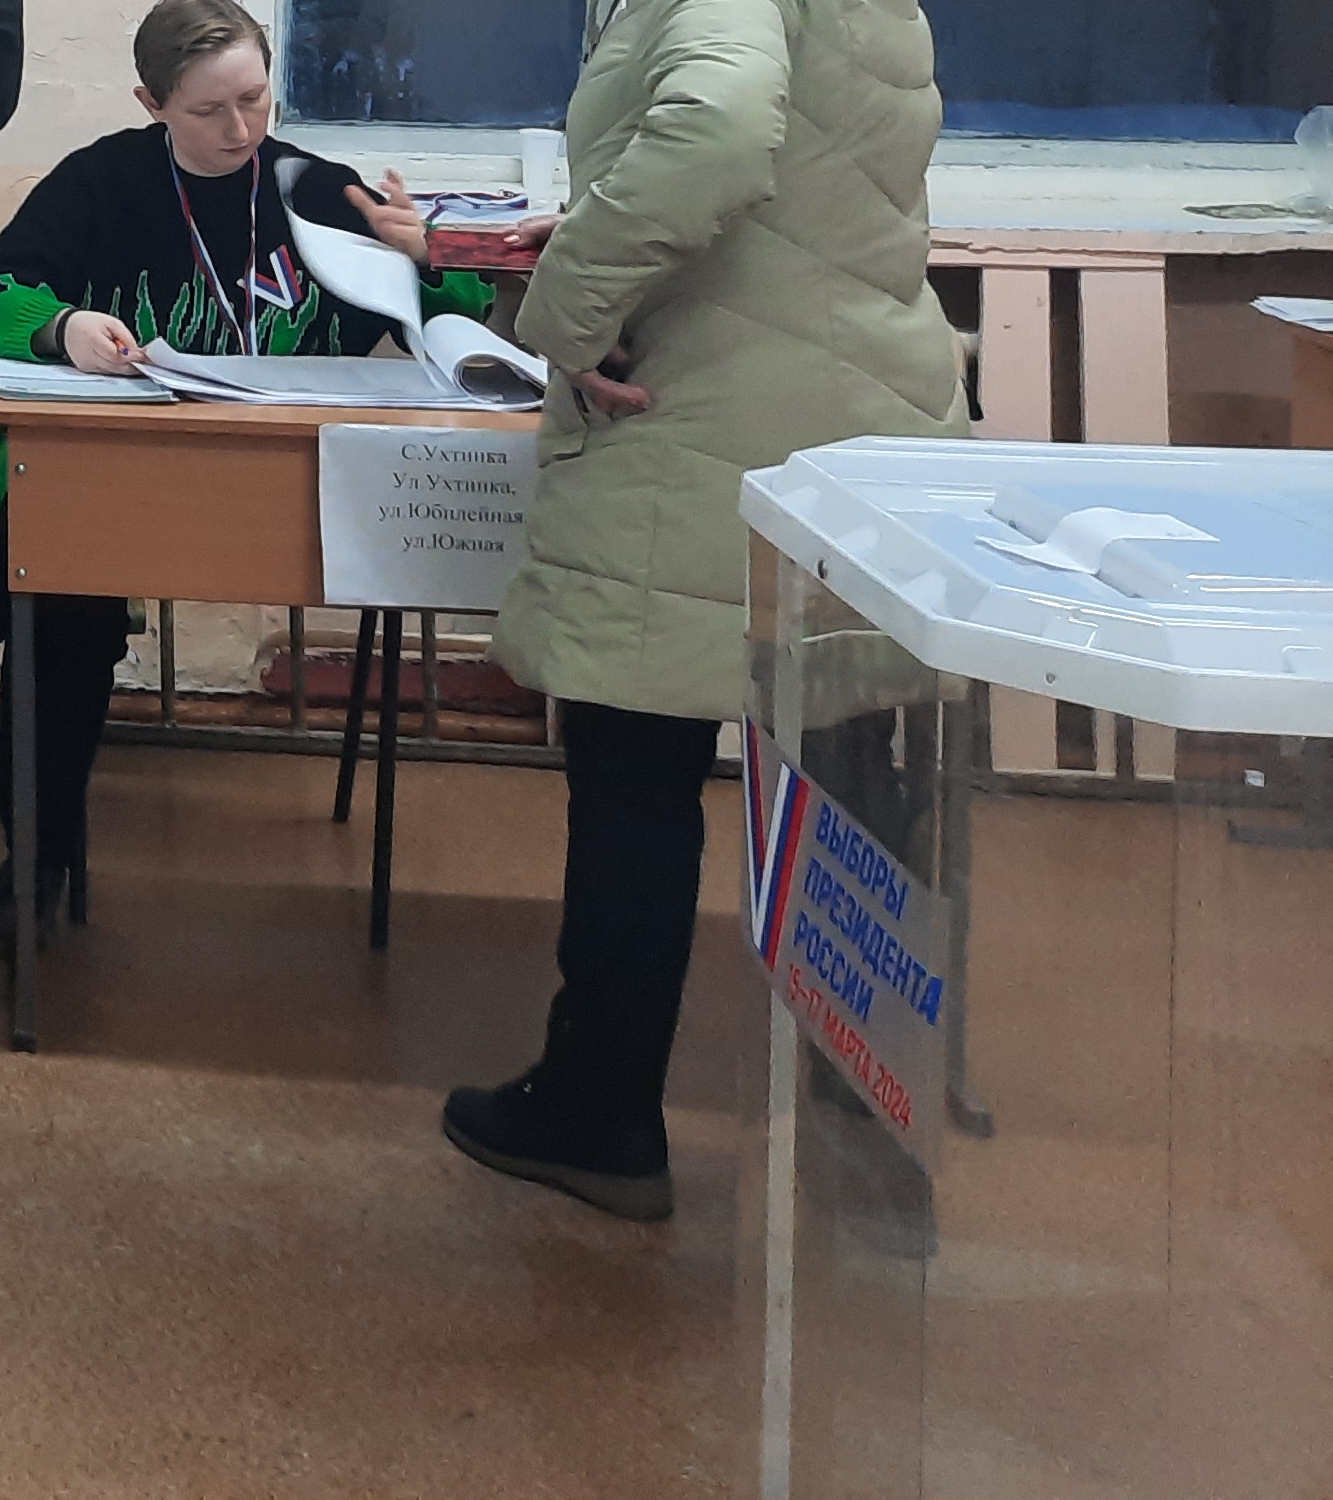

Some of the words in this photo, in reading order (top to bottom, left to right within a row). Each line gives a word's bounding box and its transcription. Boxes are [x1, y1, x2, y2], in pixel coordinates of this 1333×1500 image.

[816, 800, 909, 921] ВЫБОРЫ
[792, 910, 876, 1023] РОССИИ
[803, 856, 944, 1026] ПРЕЗИДЕНТА
[873, 1063, 913, 1130] 2024
